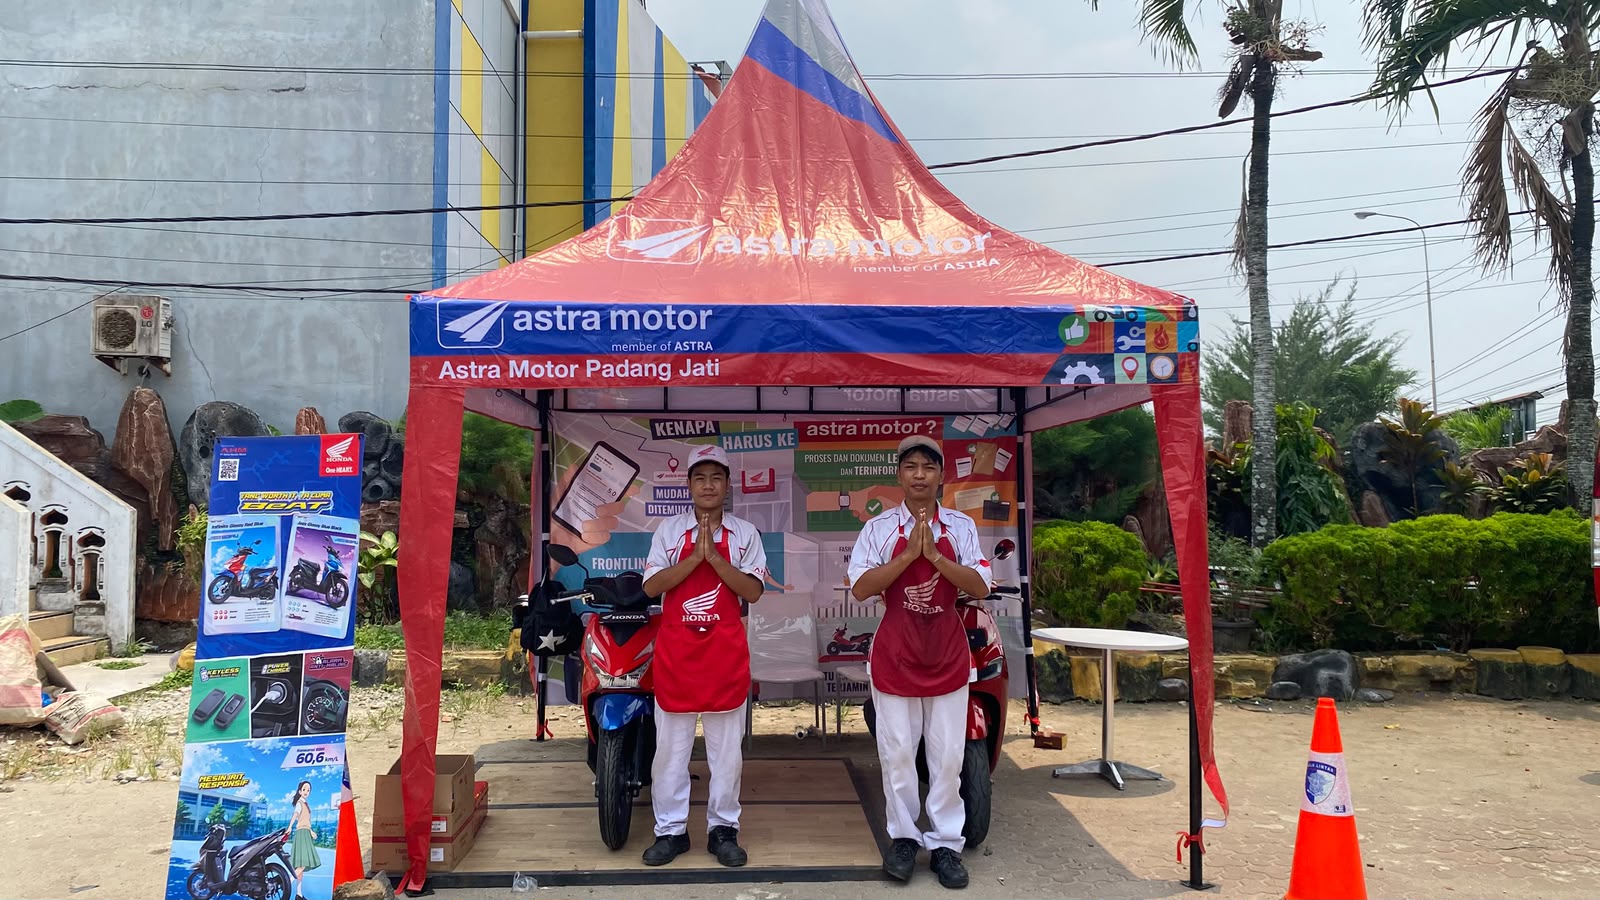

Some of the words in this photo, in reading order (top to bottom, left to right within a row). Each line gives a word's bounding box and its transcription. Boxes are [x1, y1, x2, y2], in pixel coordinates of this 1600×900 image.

[715, 232, 835, 258] astra
[850, 231, 992, 257] motor
[854, 265, 919, 273] member
[924, 264, 938, 272] of
[944, 258, 1000, 271] ASTRA
[141, 320, 152, 328] LG
[513, 305, 601, 331] astra
[610, 305, 713, 331] motor
[611, 341, 657, 352] member
[660, 341, 672, 351] of
[674, 341, 713, 351] ASTRA
[439, 361, 500, 379] Astra
[509, 360, 578, 378] Motor
[586, 359, 672, 381] Padang
[679, 358, 720, 377] Jati
[655, 420, 716, 437] KENAPA
[806, 421, 857, 436] astra
[722, 433, 773, 450] HARUS
[777, 432, 796, 448] KE
[804, 454, 832, 463] PROSES
[833, 454, 848, 463] DAN
[850, 453, 885, 463] DOKUMEN
[841, 468, 853, 476] DAN
[656, 488, 689, 499] MUDAH
[903, 601, 944, 615] HONDA
[207, 667, 240, 675] KEYLESS
[296, 752, 325, 764] 60,6
[199, 780, 249, 789] RESPONSIF
